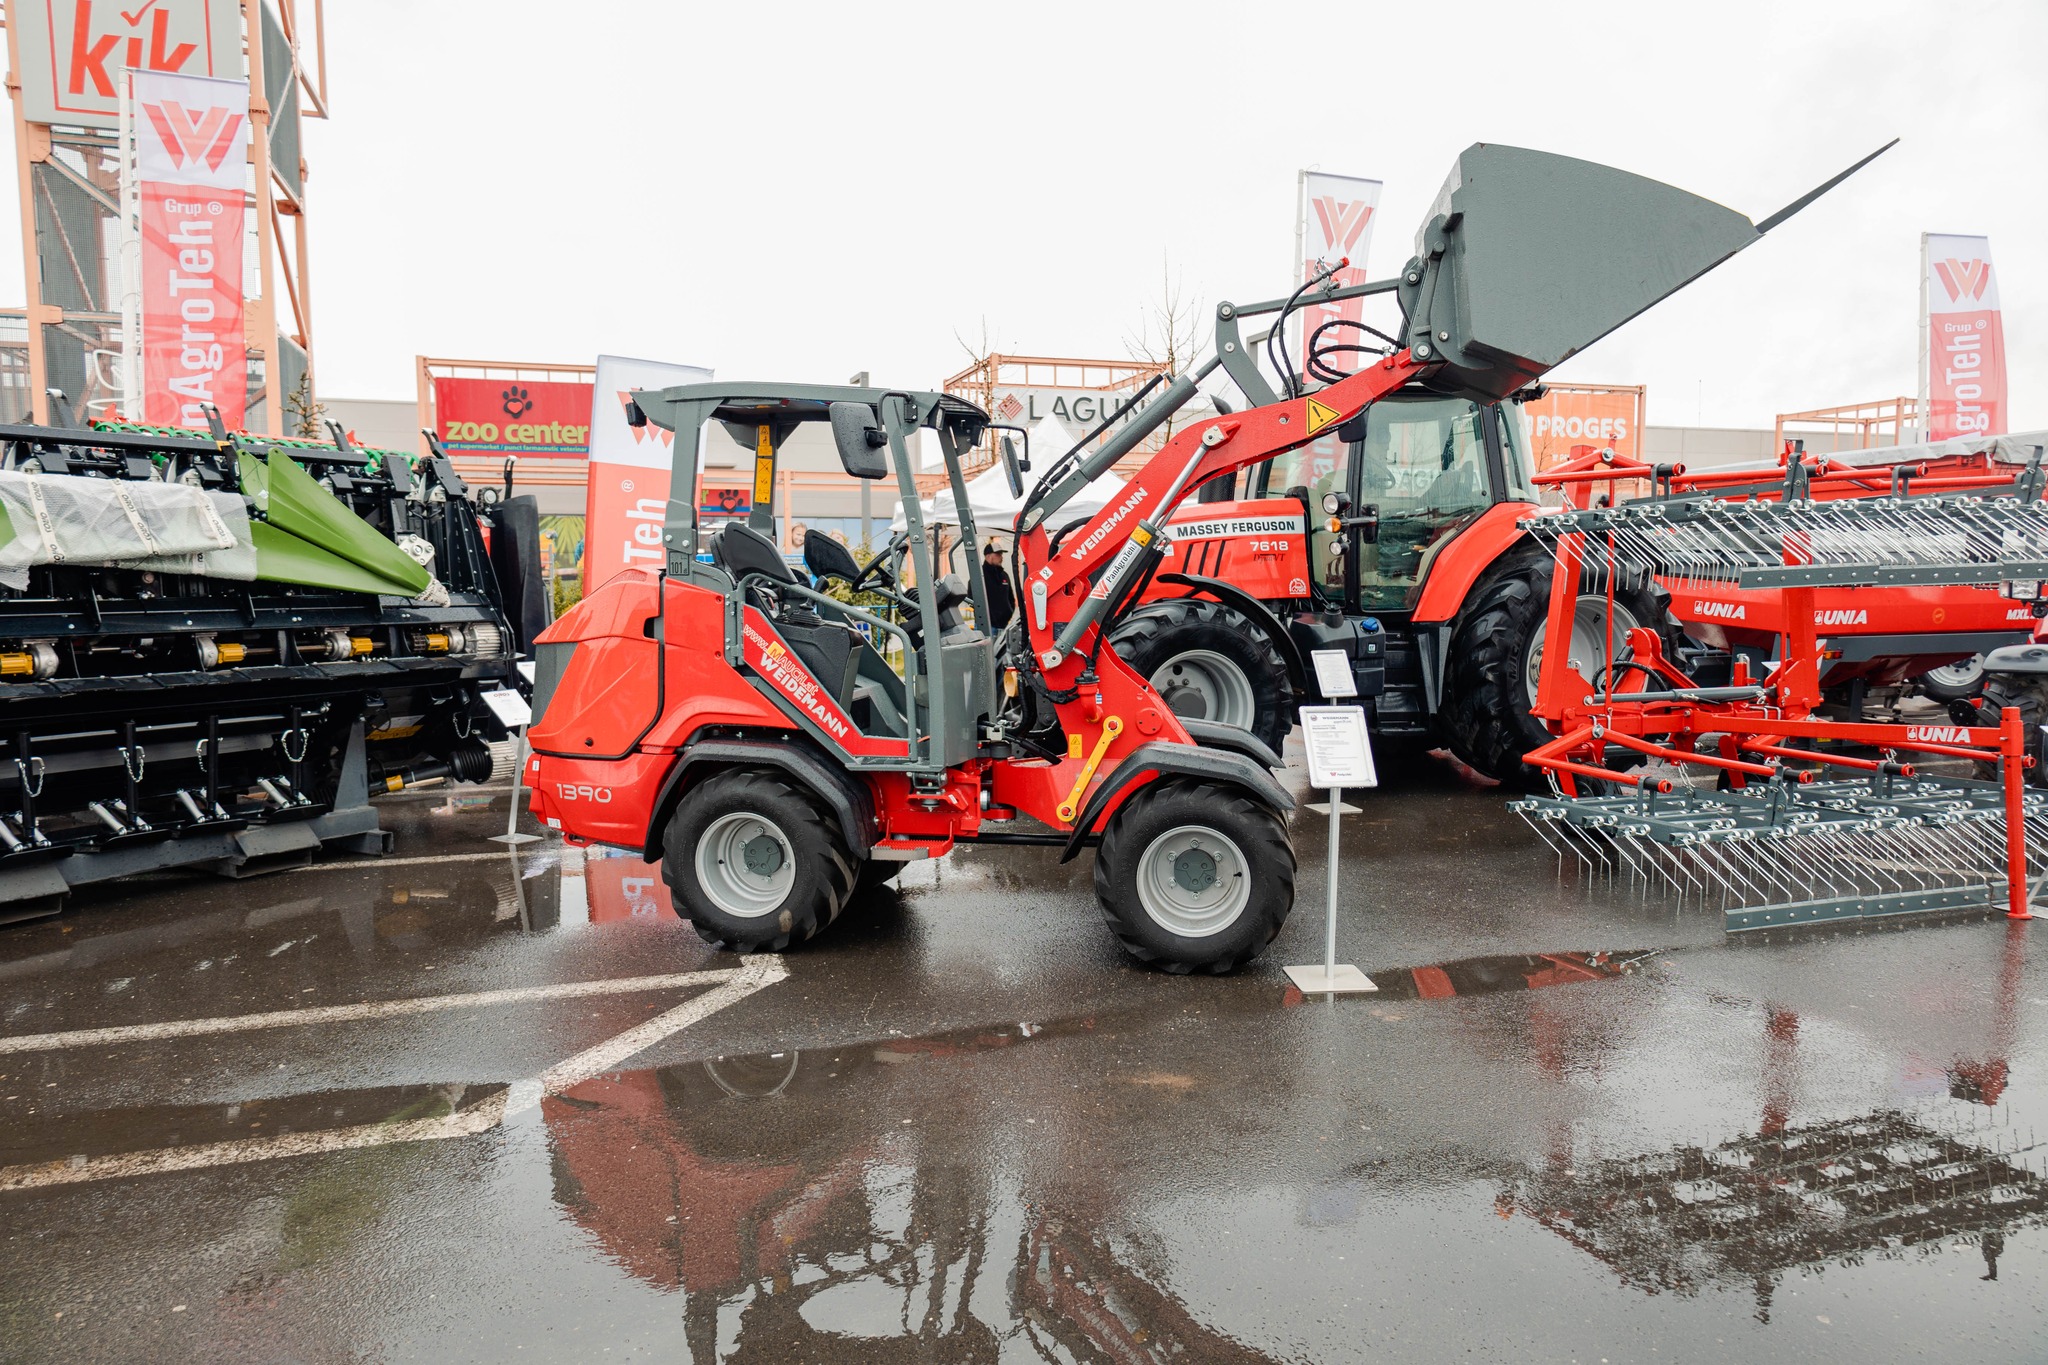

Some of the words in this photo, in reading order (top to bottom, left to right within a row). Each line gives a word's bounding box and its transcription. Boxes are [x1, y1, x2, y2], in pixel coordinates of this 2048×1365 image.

[165, 198, 202, 215] Grup
[1944, 322, 1972, 333] Grup
[445, 421, 499, 443] zoo
[504, 420, 588, 445] center
[1536, 415, 1627, 439] PROGES
[1071, 486, 1149, 561] WEIDEMANN
[1177, 523, 1229, 538] MASSEY
[1232, 520, 1295, 533] FERGUSON
[1249, 540, 1289, 552] 7618
[671, 561, 683, 574] 101
[1702, 602, 1746, 620] UNIA
[1822, 609, 1868, 626] UNIA
[2006, 608, 2029, 620] MXL
[760, 652, 849, 739] WEIDEMANN
[1918, 727, 1971, 743] UNIA
[556, 783, 612, 804] 1390
